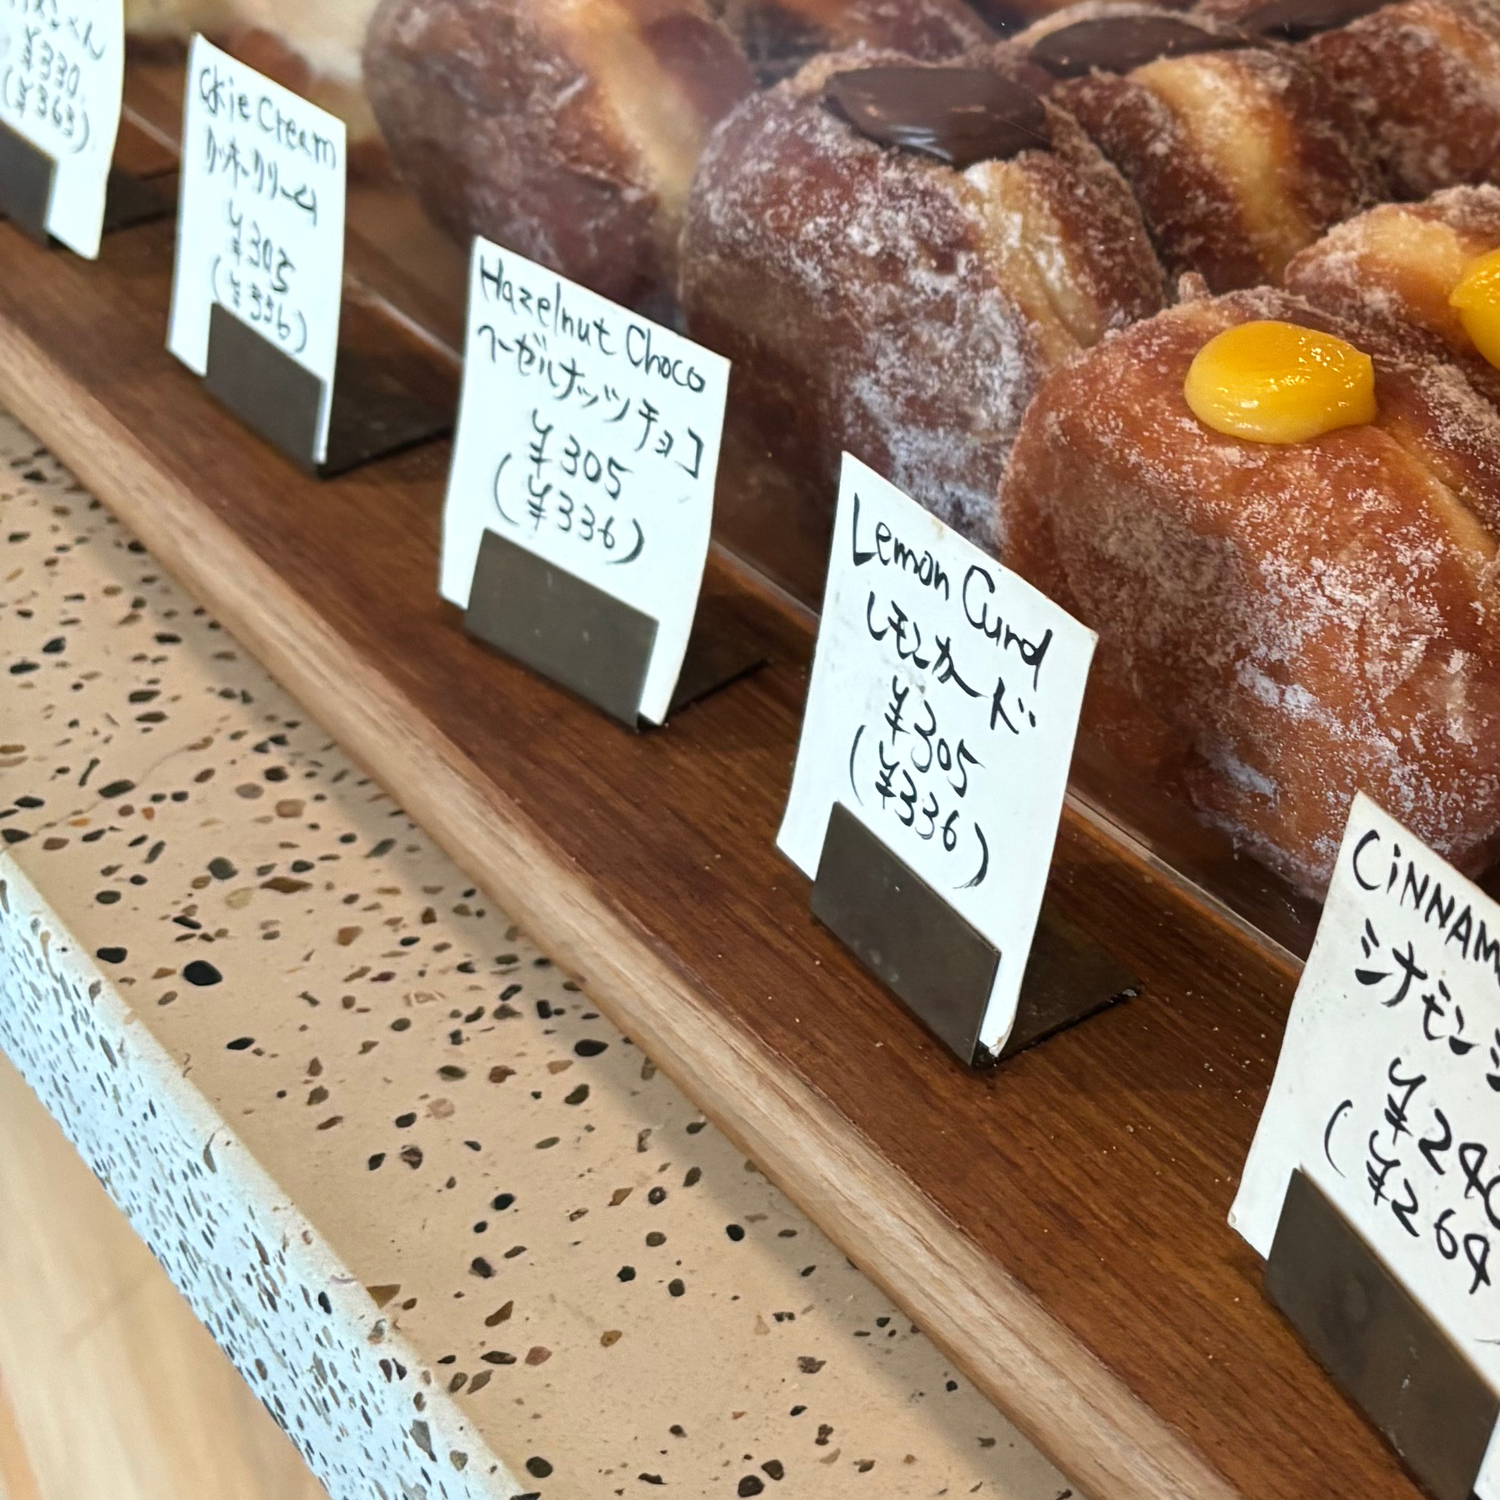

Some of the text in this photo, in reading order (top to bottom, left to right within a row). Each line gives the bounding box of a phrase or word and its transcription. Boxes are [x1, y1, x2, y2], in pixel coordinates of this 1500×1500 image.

[21, 23, 80, 100] ¥330
[258, 96, 337, 171] Cream
[227, 198, 297, 294] ¥305
[479, 254, 707, 393] Hazelnut Choco
[477, 324, 705, 480] ヘーゼルナッツチョコ
[529, 408, 635, 501] ¥305
[493, 453, 645, 566] (¥336)
[852, 492, 1053, 692] Lemon Curd
[883, 675, 988, 798] ¥305
[849, 725, 989, 890] (¥336)
